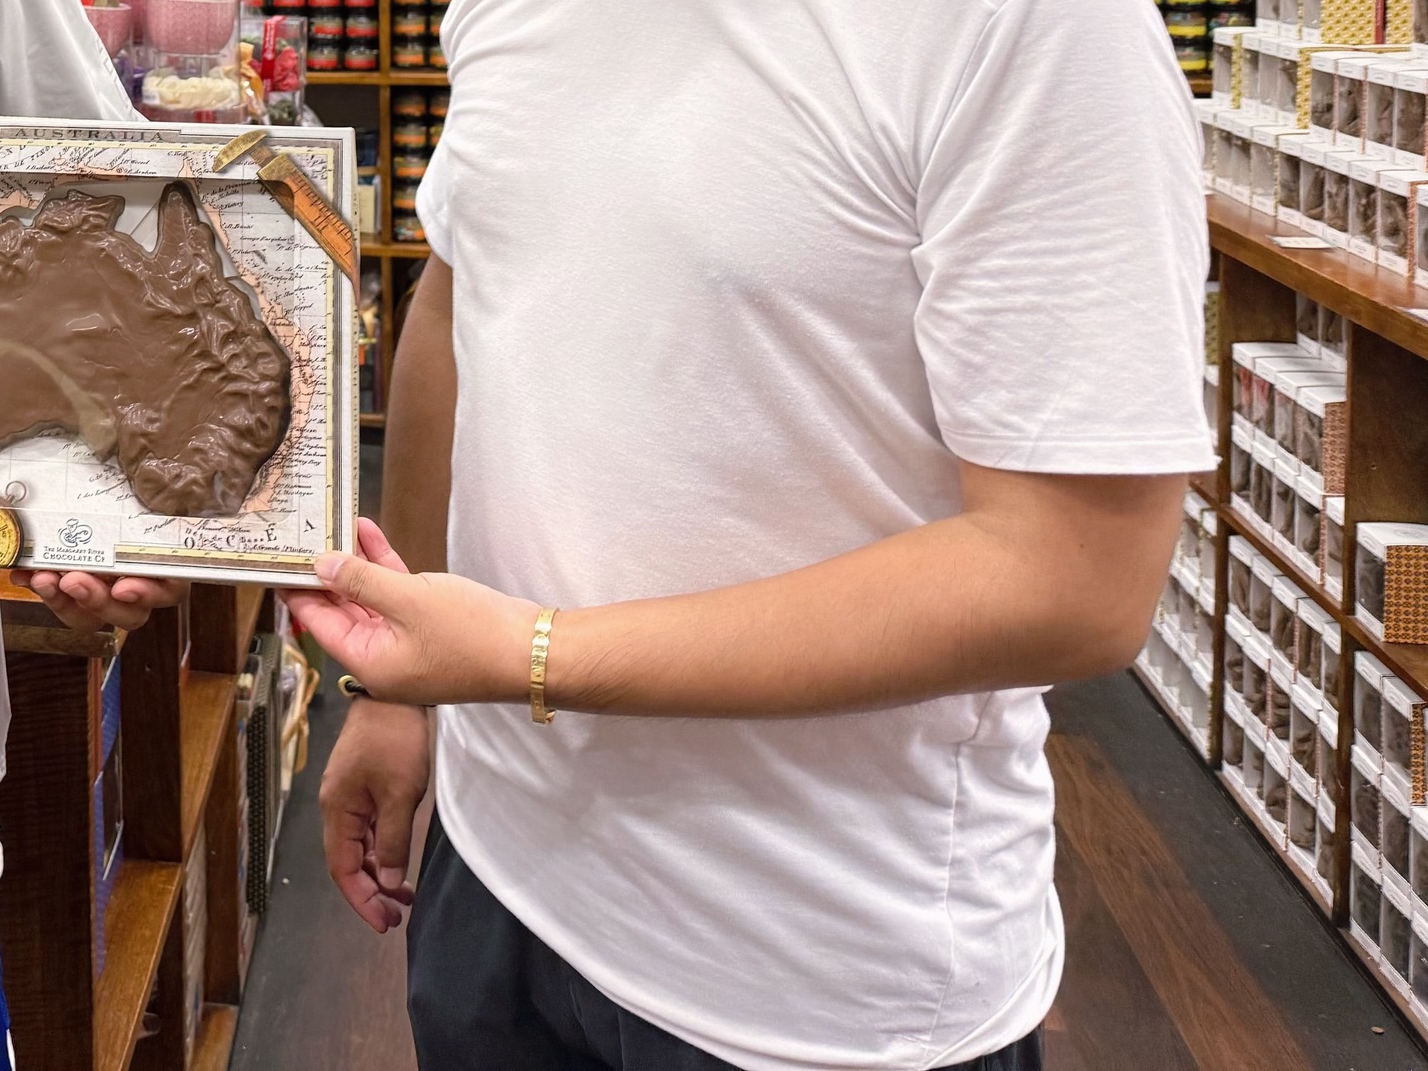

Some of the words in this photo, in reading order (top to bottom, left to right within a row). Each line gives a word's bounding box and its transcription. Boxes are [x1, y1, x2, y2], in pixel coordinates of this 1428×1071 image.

[15, 129, 164, 142] AUSTRALIA
[57, 546, 86, 555] MARGARET
[43, 553, 92, 562] CHOCOLATE
